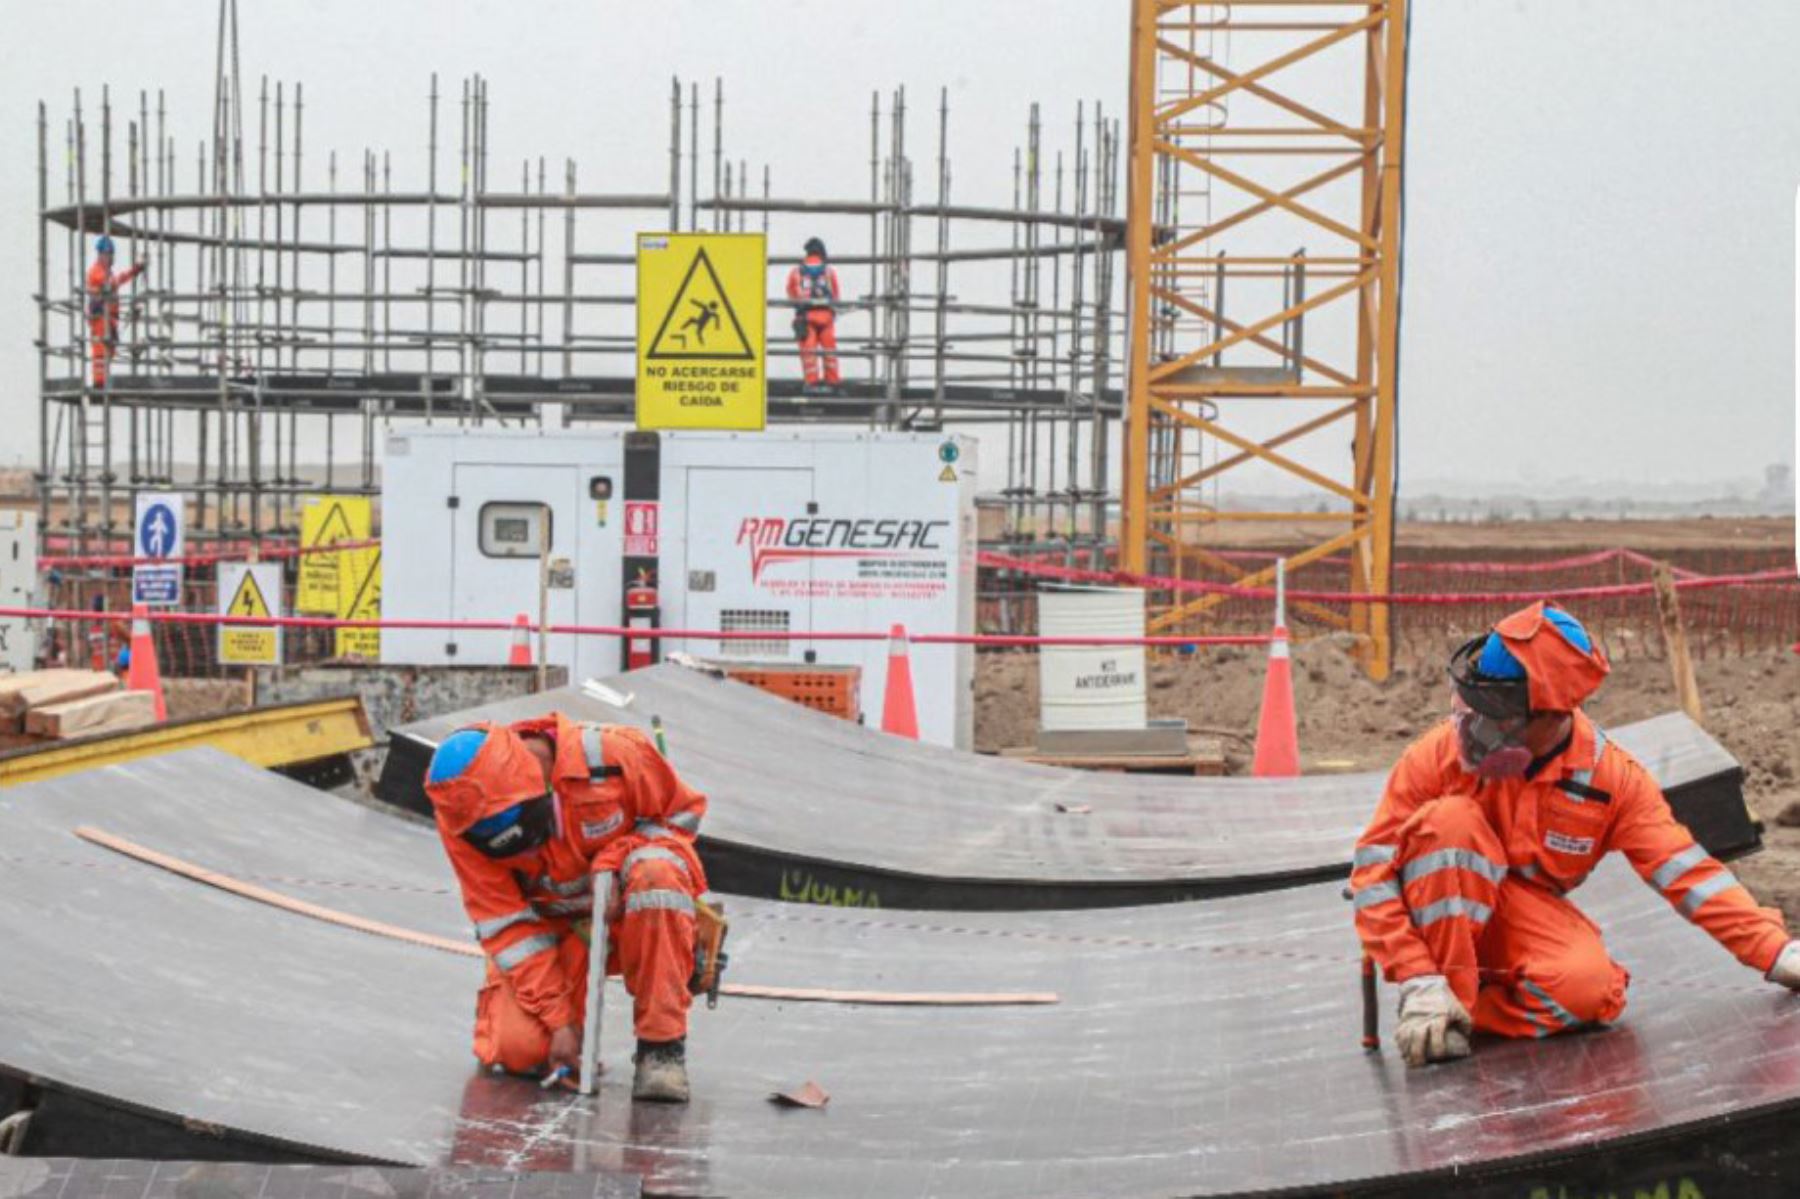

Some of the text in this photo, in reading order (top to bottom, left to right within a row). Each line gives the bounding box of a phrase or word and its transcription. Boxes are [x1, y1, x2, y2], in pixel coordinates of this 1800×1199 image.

[646, 366, 756, 379] NO ACERCARSE
[662, 380, 739, 393] RIESGO DE
[679, 395, 724, 407] CAIDA
[1100, 659, 1117, 672] KIT
